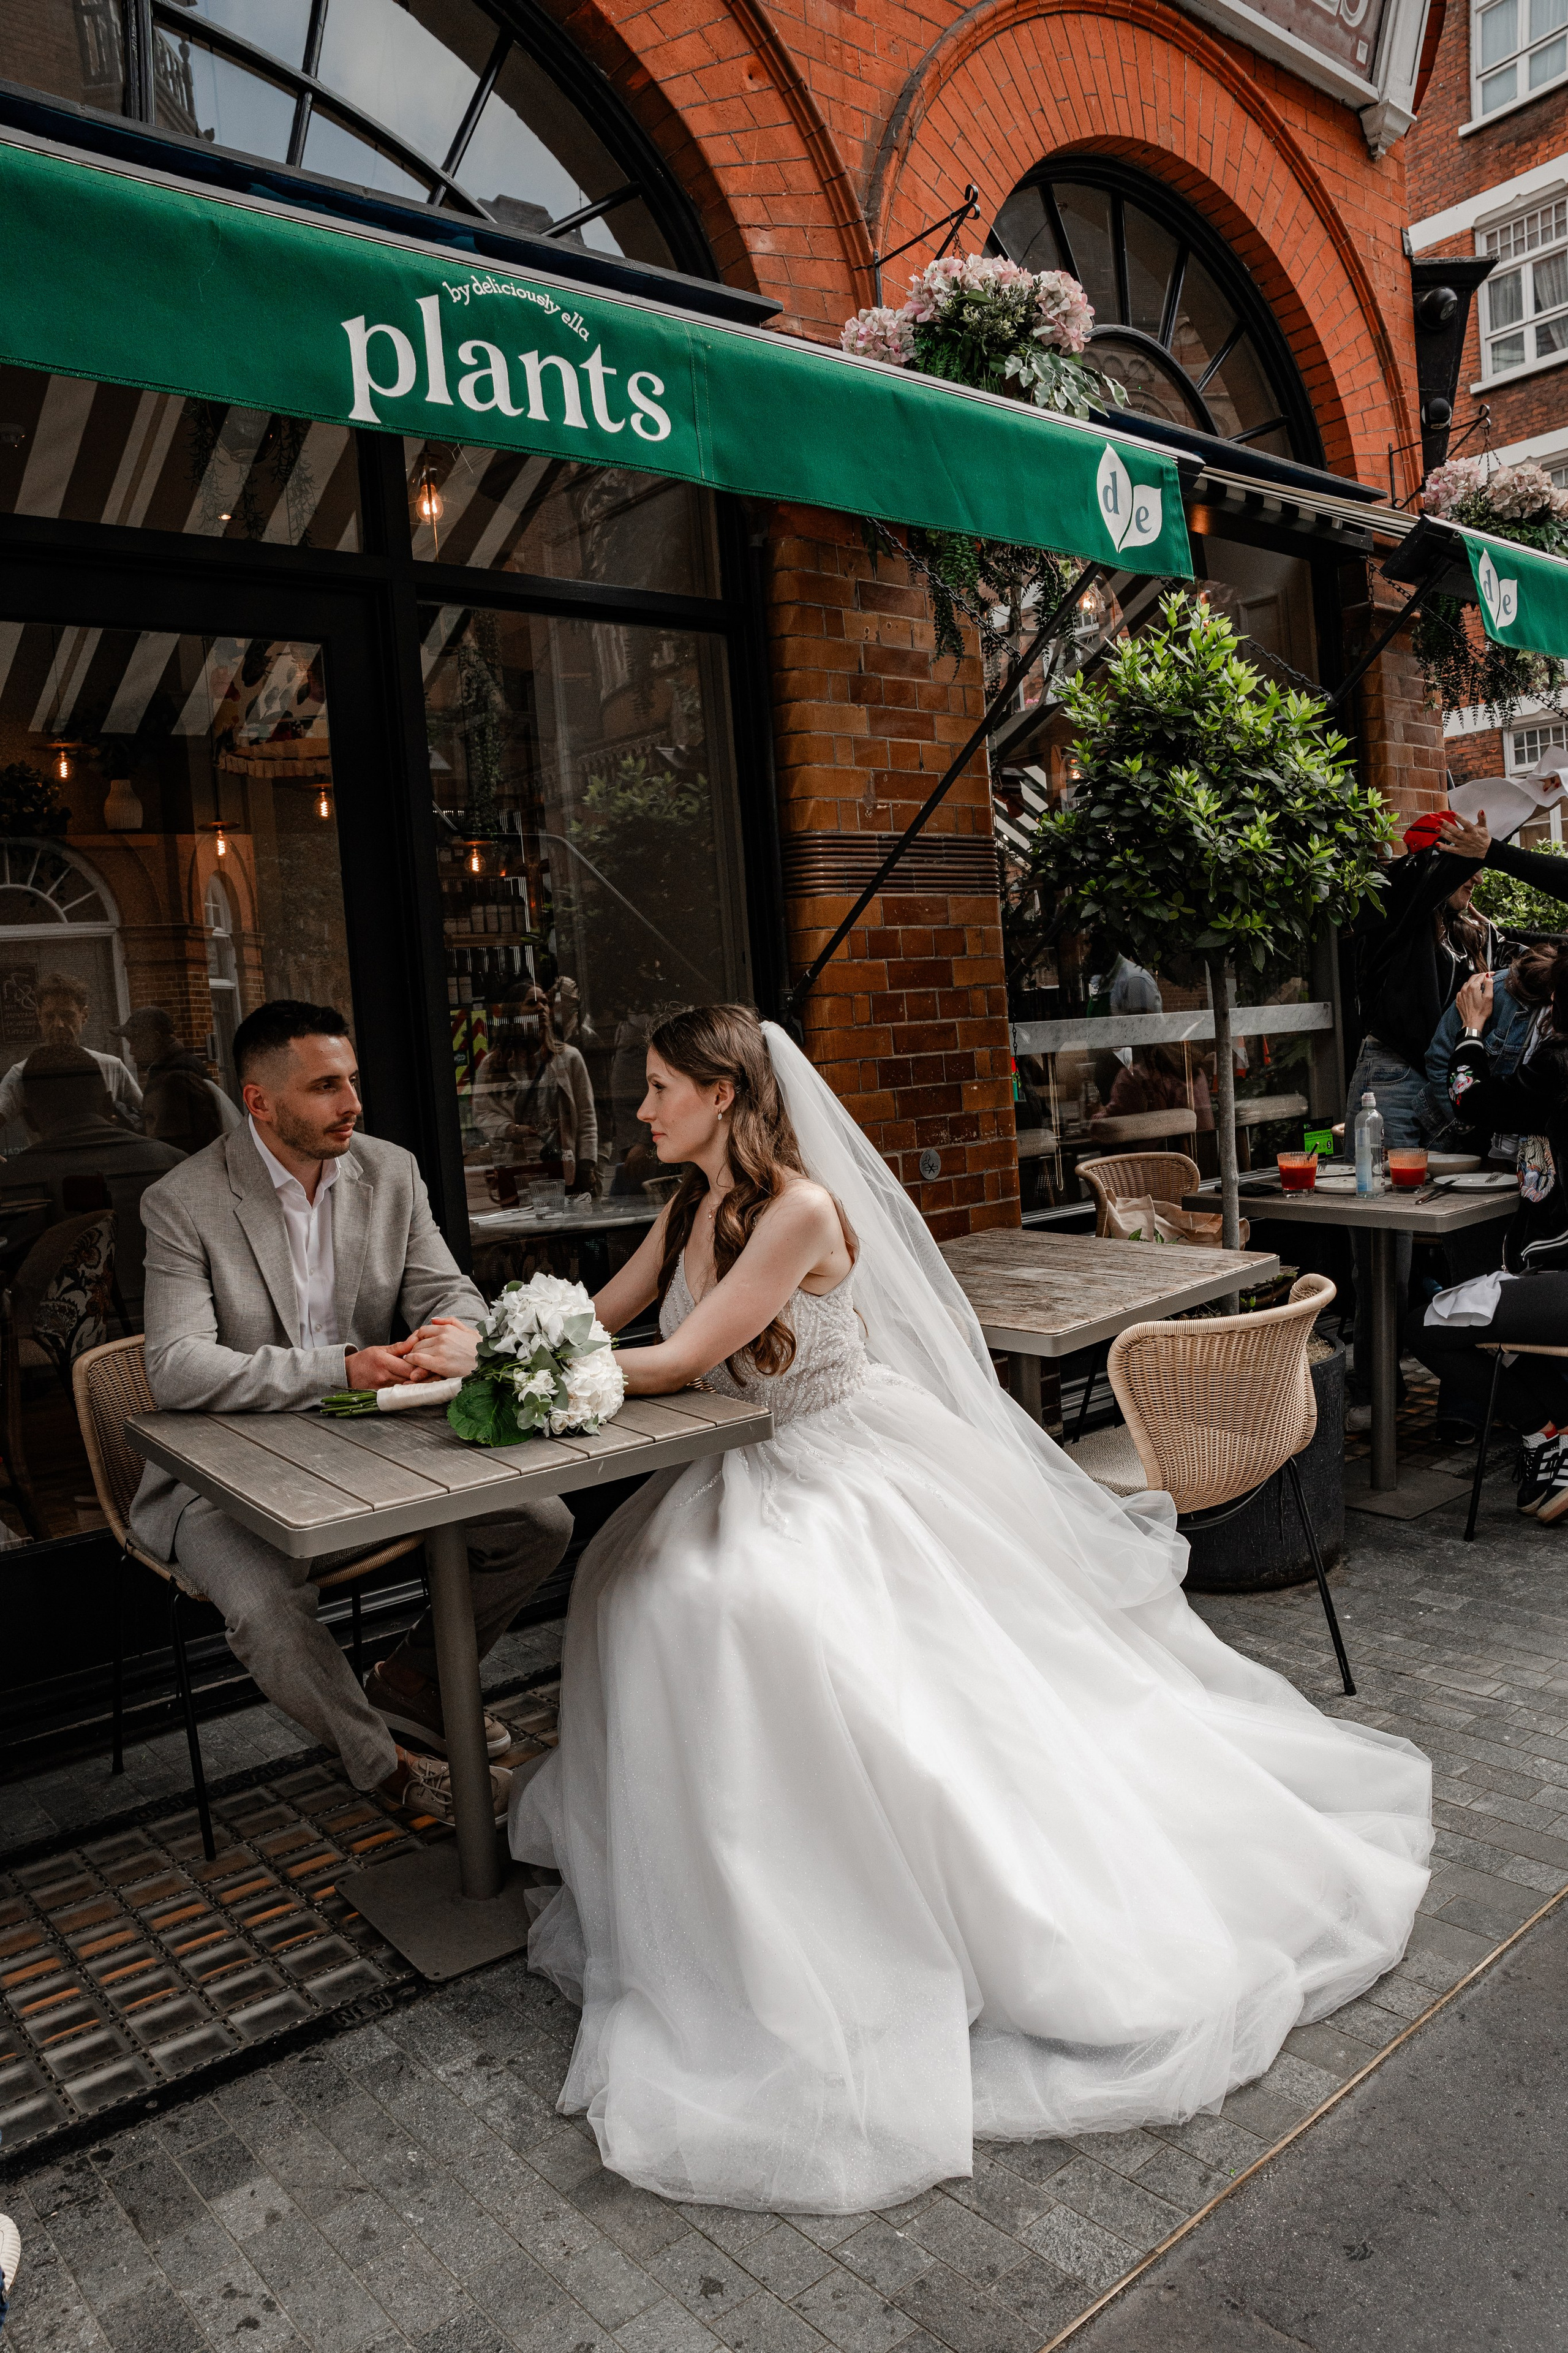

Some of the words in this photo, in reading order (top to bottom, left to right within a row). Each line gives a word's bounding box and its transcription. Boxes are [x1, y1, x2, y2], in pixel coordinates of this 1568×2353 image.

[442, 281, 470, 306] by
[470, 275, 561, 315] deliciously
[561, 311, 590, 342] ella
[341, 294, 671, 442] plants
[336, 1995, 393, 2025] NEW
